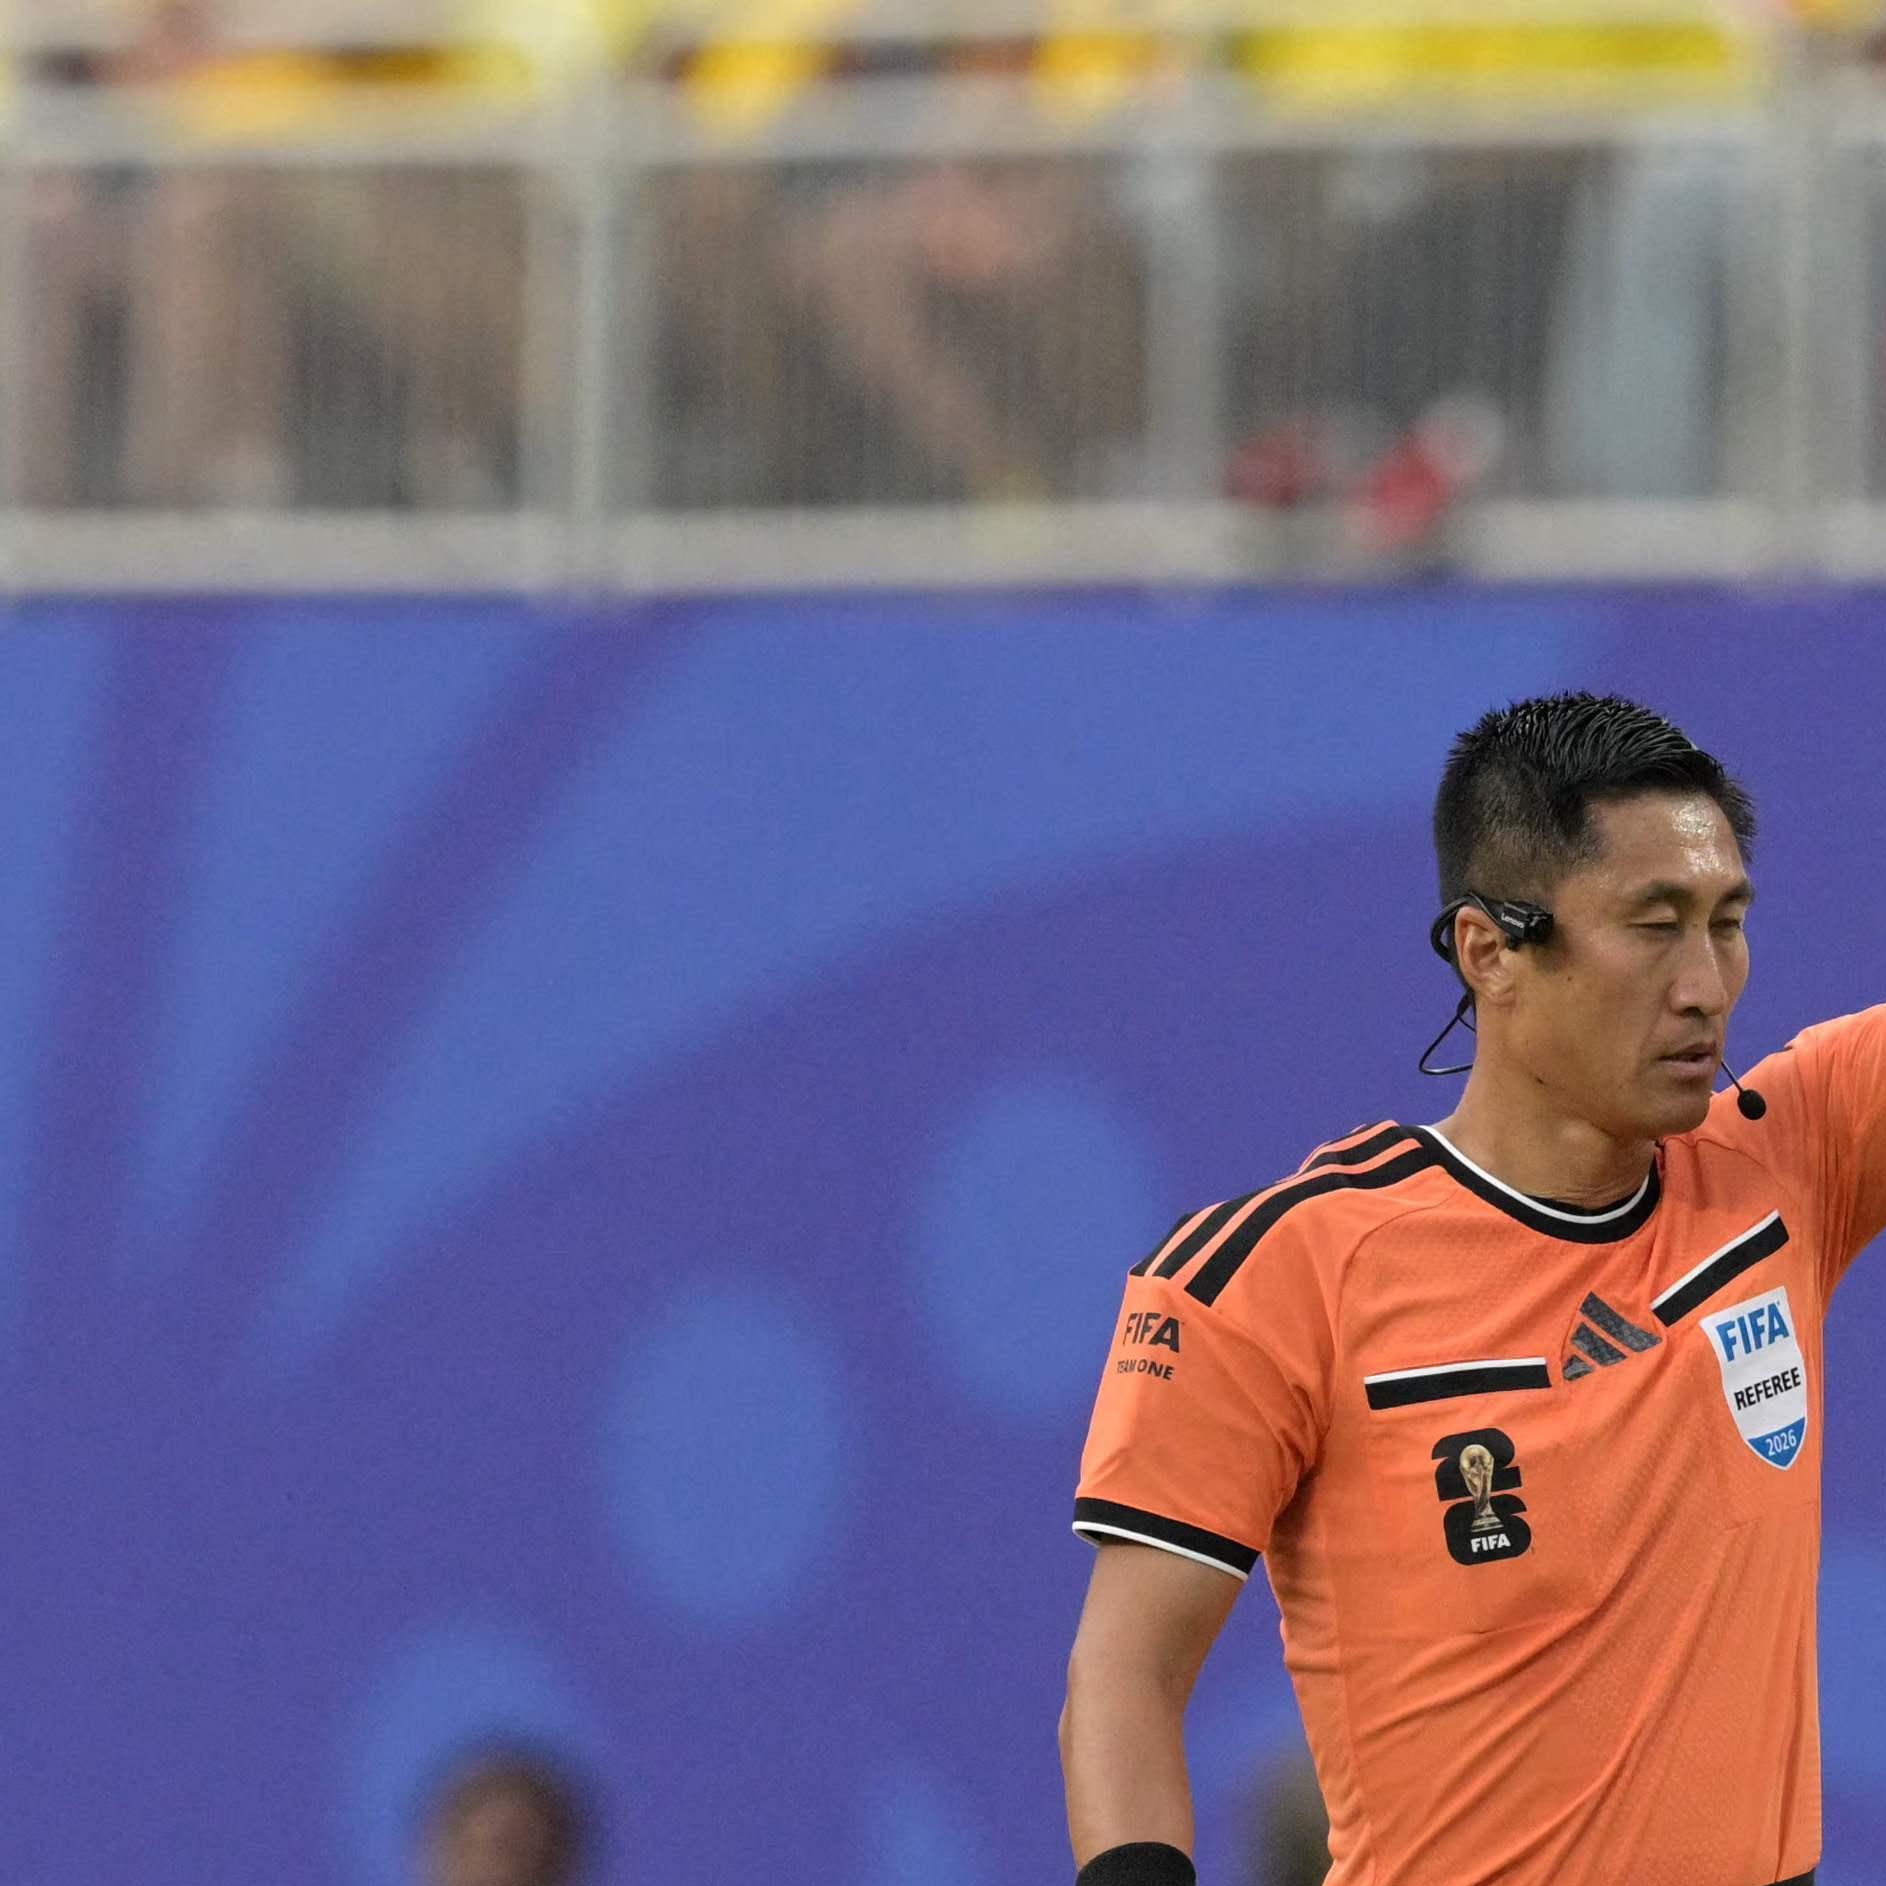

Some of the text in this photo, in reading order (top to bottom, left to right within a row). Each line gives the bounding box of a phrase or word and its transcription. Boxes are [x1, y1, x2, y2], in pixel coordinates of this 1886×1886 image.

[1122, 1311, 1180, 1354] FIFA
[1715, 1301, 1790, 1363] FIFA
[1137, 1359, 1174, 1380] ONE
[1734, 1366, 1802, 1412] REFEREE
[1765, 1428, 1799, 1457] 2026
[1470, 1533, 1512, 1553] FIFA
